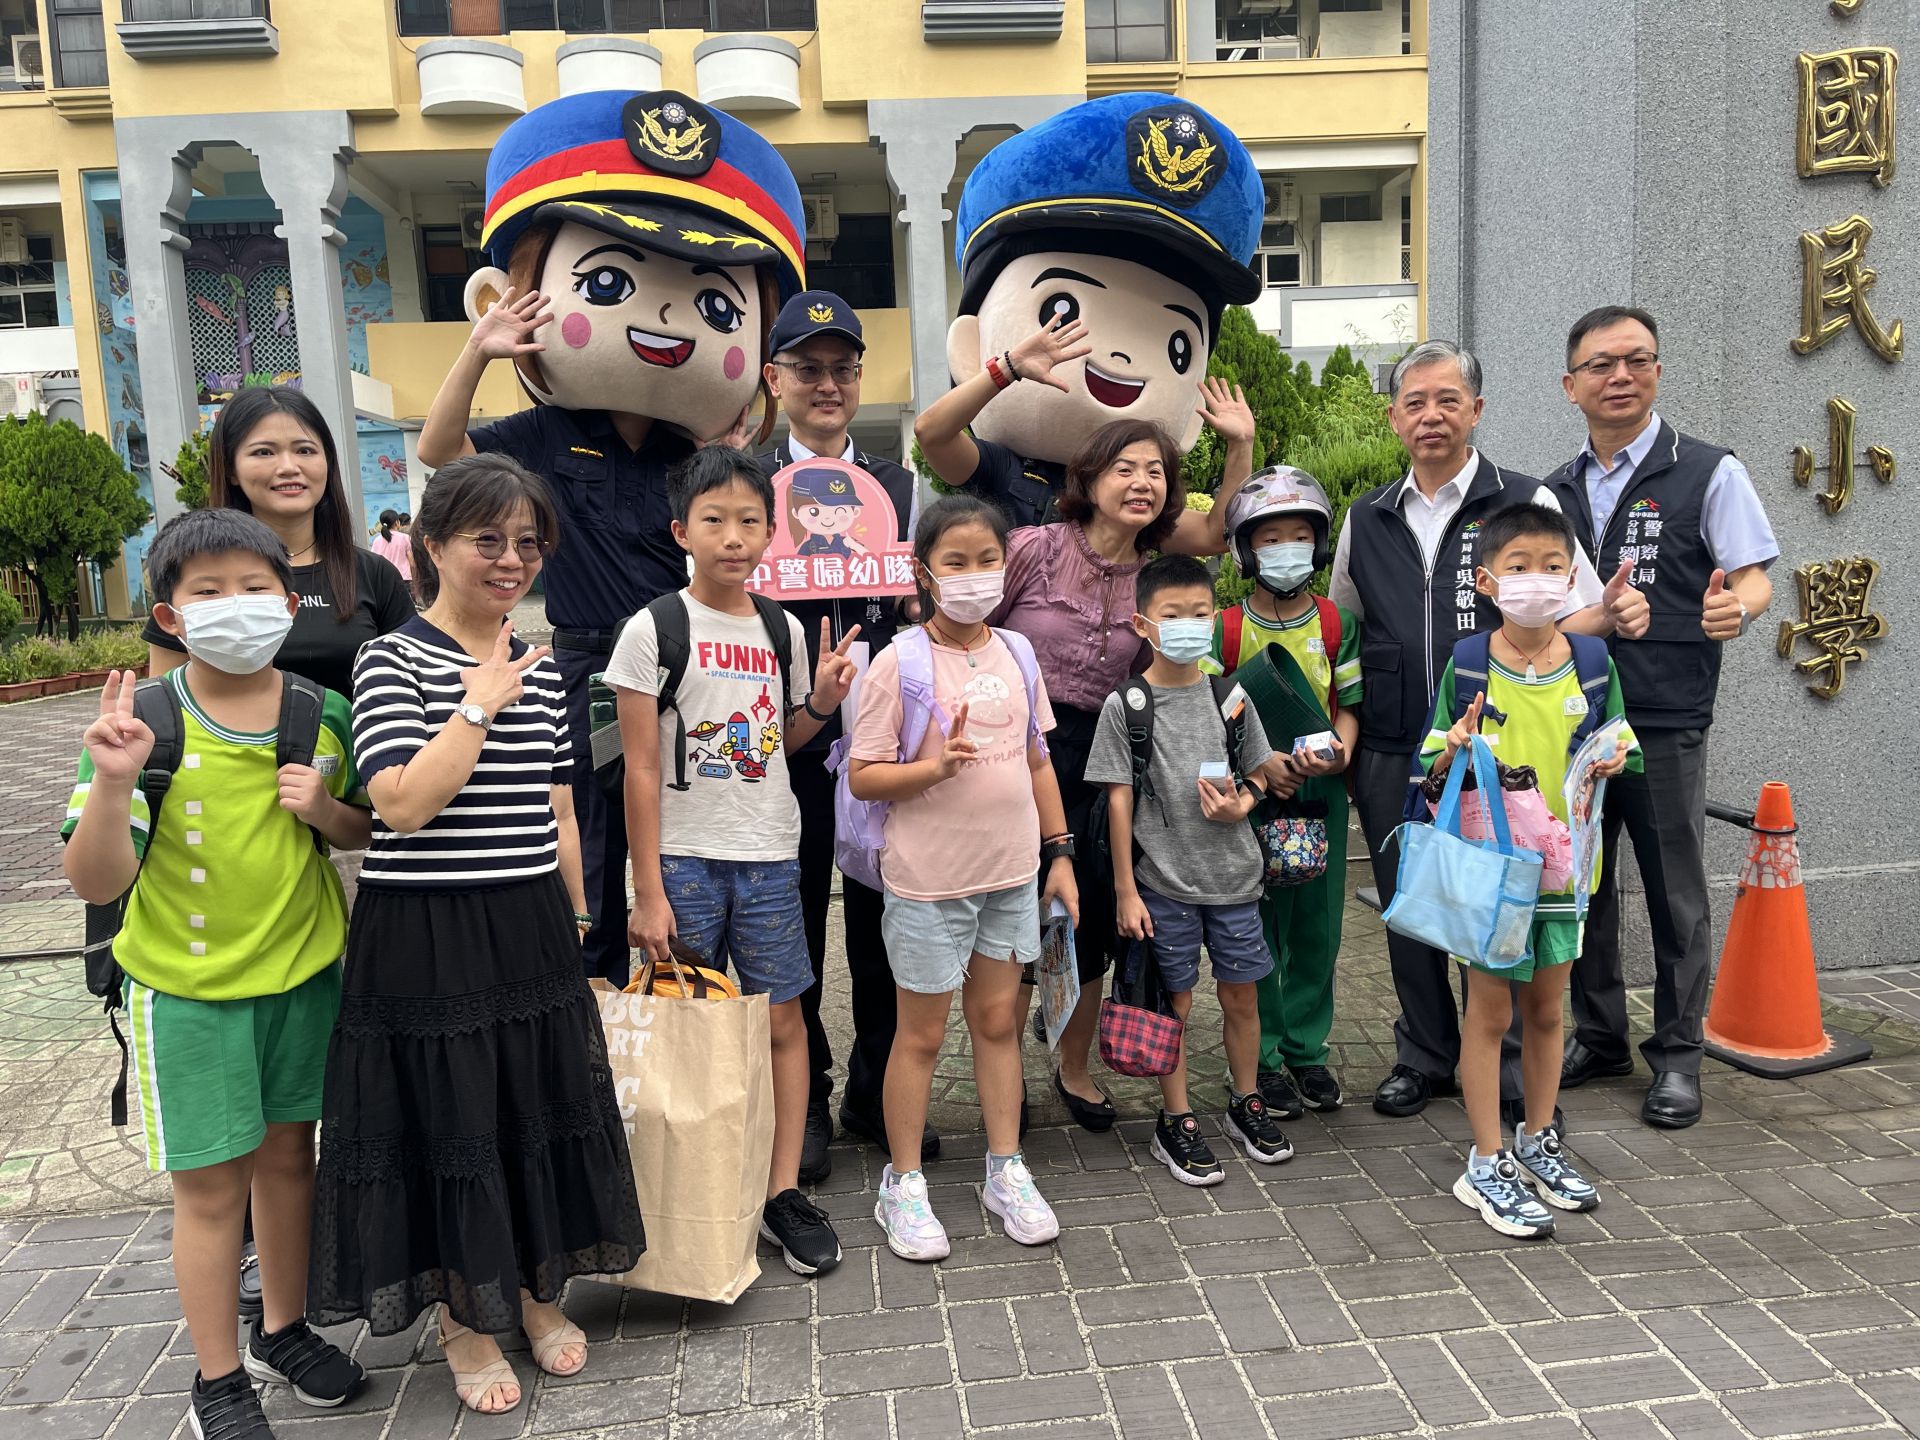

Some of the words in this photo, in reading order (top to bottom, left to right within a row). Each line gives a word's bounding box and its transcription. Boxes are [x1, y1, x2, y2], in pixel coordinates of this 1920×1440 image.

[1777, 0, 1904, 698] 國民小學
[1640, 520, 1663, 584] 警察局
[697, 642, 779, 676] FUNNY
[711, 670, 730, 679] SPACE
[747, 674, 770, 683] MACHINE
[604, 1026, 651, 1057] RT
